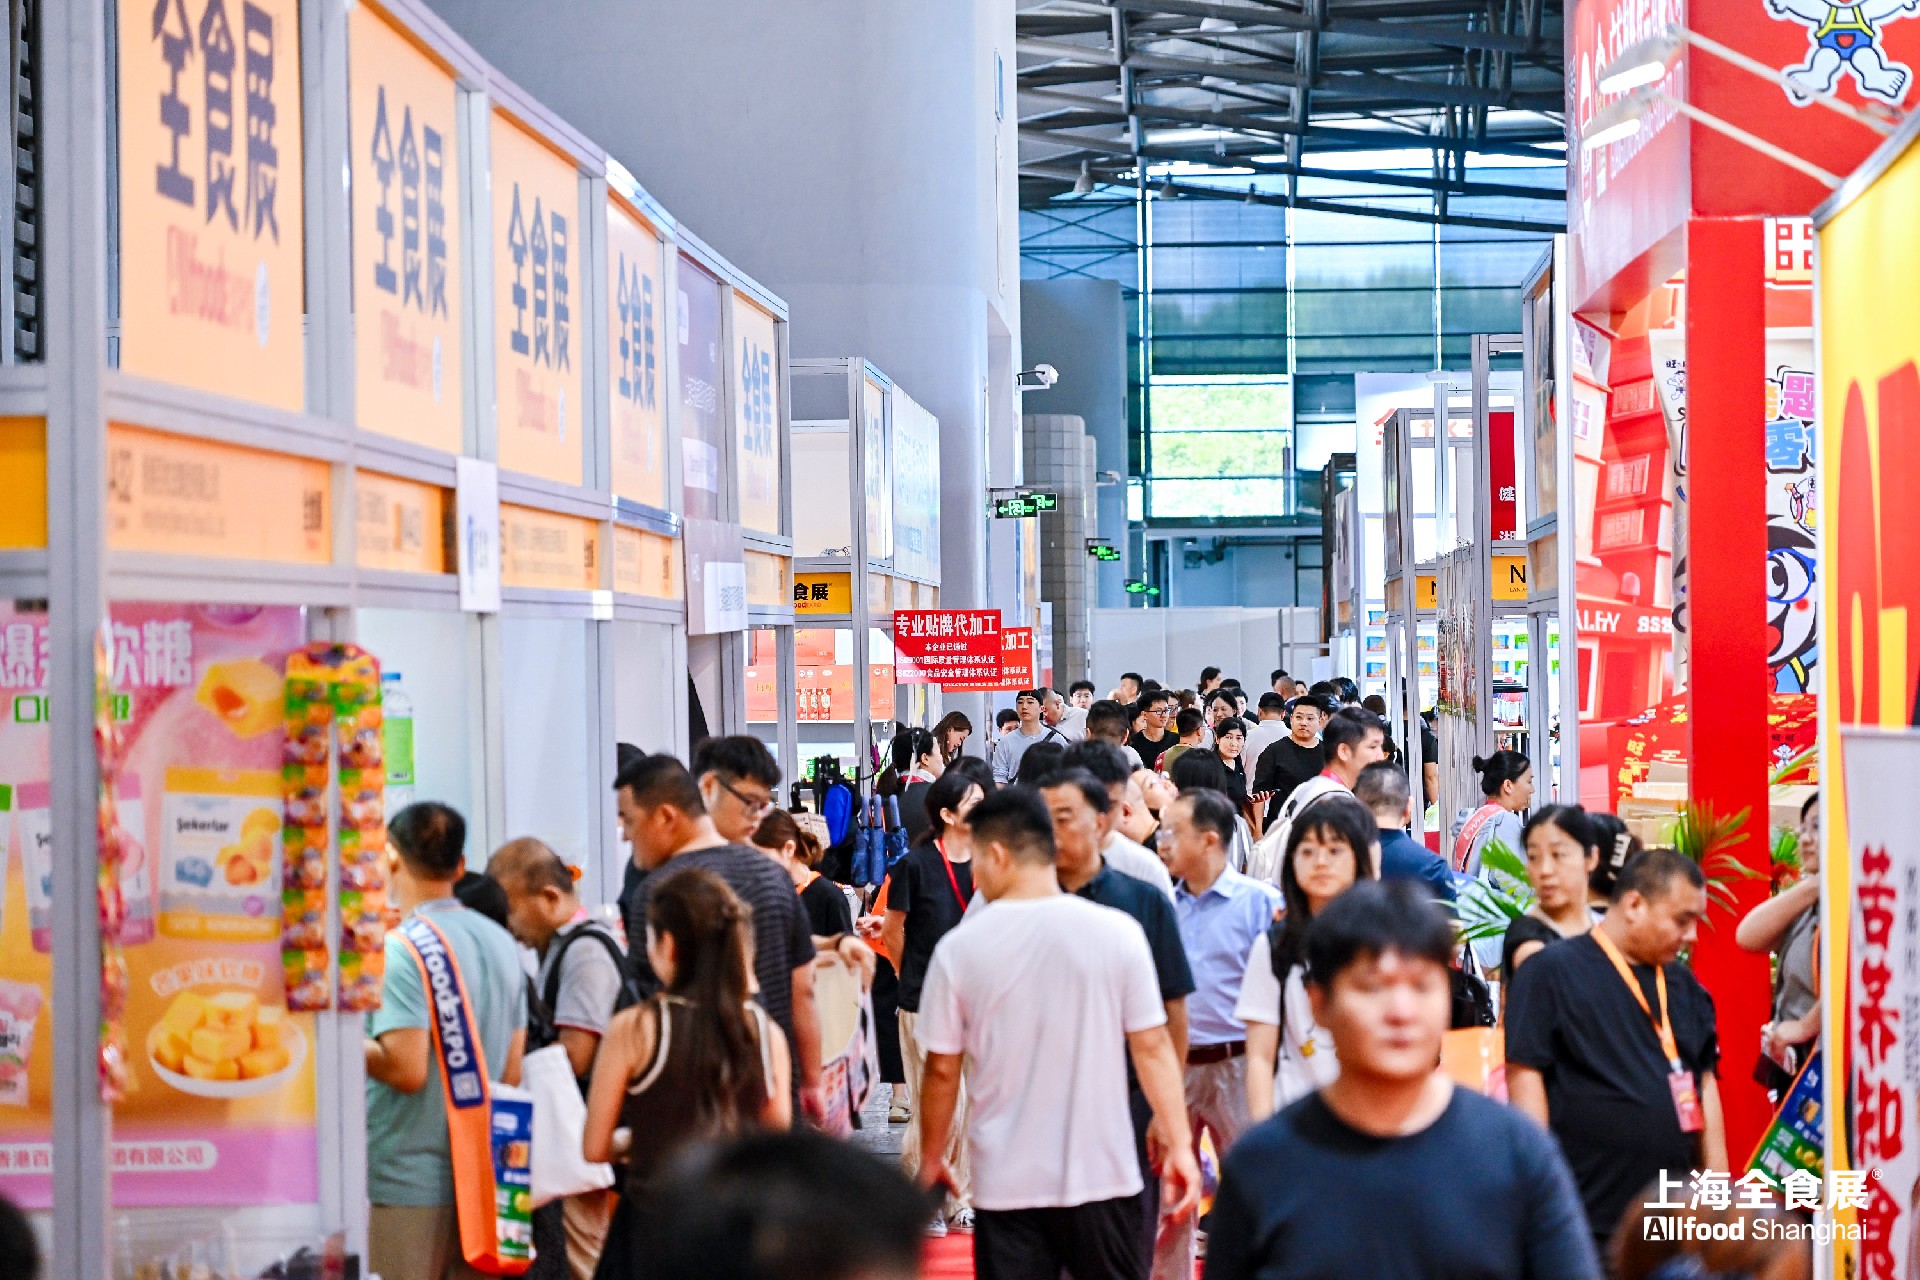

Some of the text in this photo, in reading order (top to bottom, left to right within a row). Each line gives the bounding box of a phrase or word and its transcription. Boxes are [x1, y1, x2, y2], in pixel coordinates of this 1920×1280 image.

[371, 84, 448, 320] 全食展
[508, 181, 571, 375] 全食展
[617, 251, 657, 413] 全食展
[895, 613, 998, 637] 专业贴牌代加工
[925, 642, 968, 652] 本企业已通过
[1001, 630, 1030, 651] 加工
